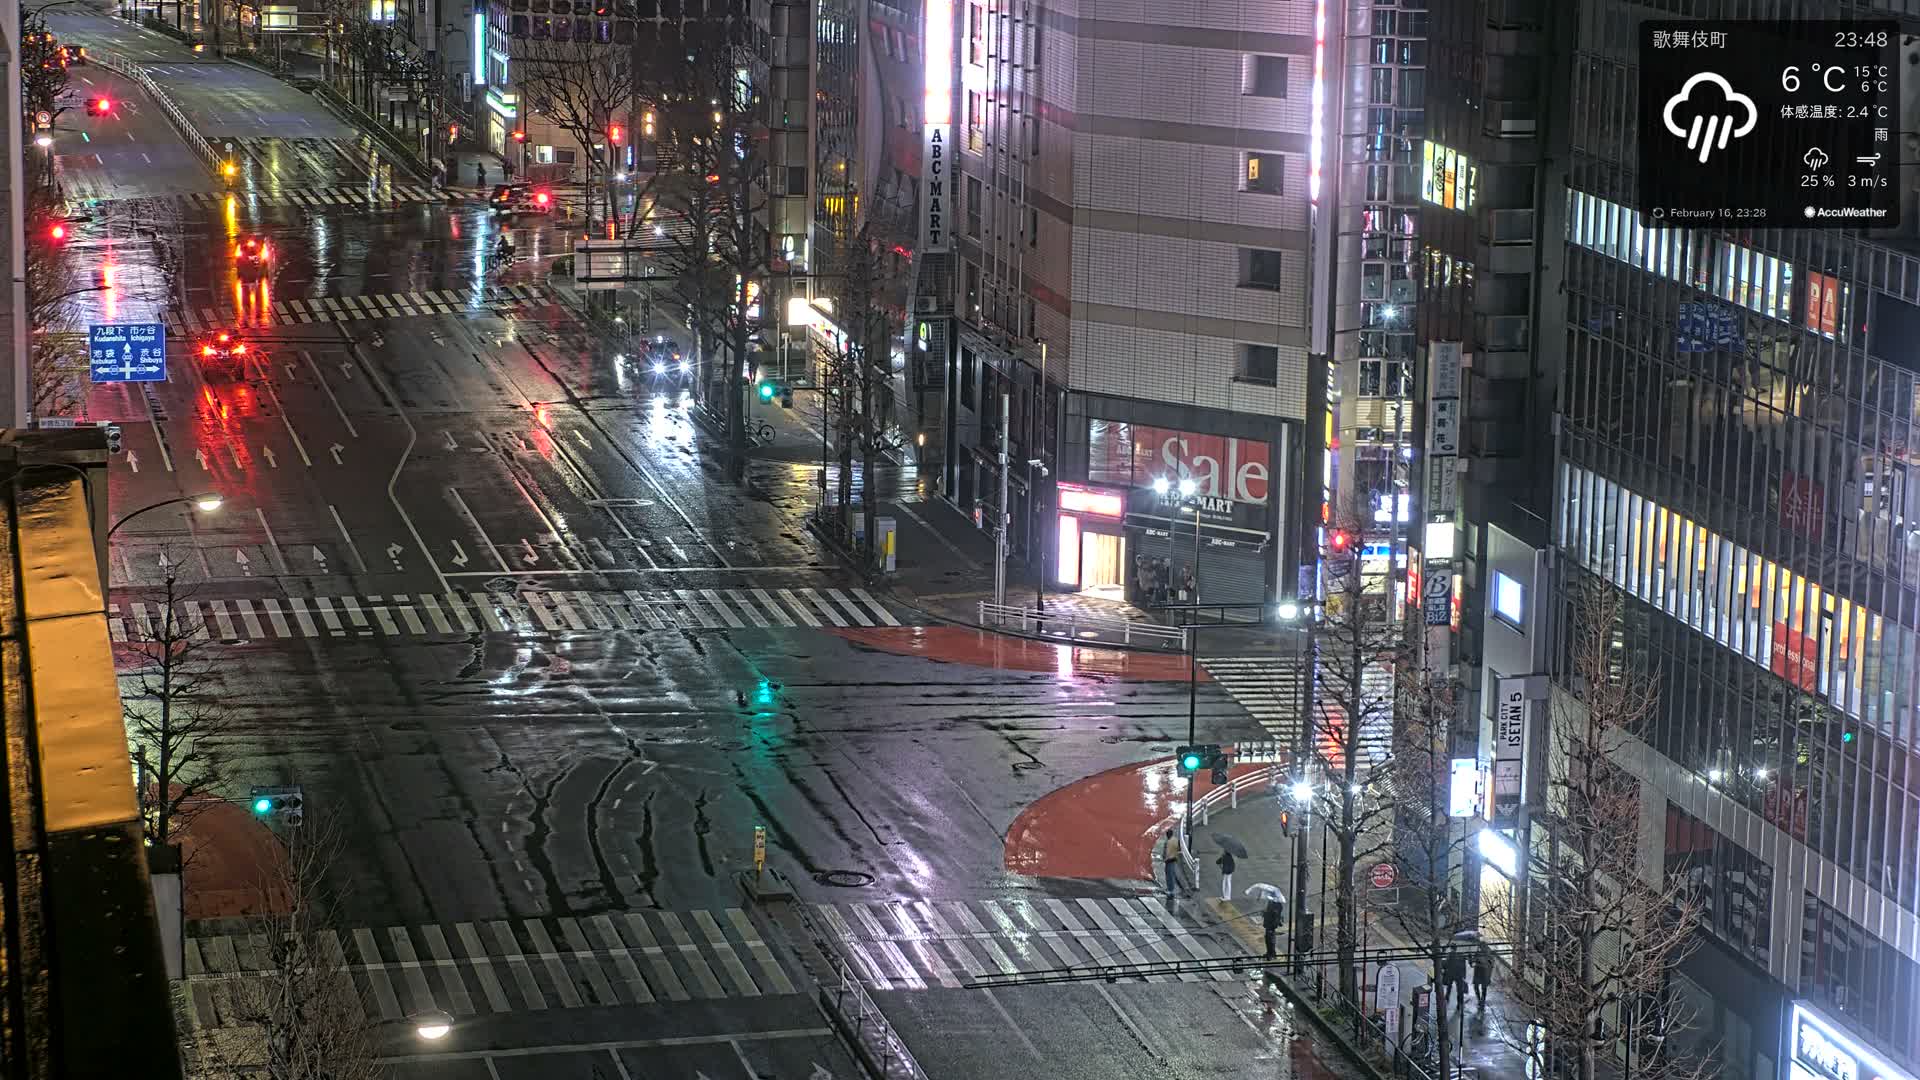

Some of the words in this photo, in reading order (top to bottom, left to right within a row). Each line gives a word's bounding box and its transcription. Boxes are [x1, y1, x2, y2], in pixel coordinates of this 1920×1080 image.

[96, 326, 125, 335] 九段下
[131, 335, 155, 343] Ichigaya
[93, 349, 115, 358] 池袋
[1161, 437, 1268, 503] Sale
[1435, 515, 1446, 523] 7F
[1510, 692, 1522, 702] 5
[1500, 722, 1508, 740] PARK
[1508, 706, 1521, 747] ISETAN
